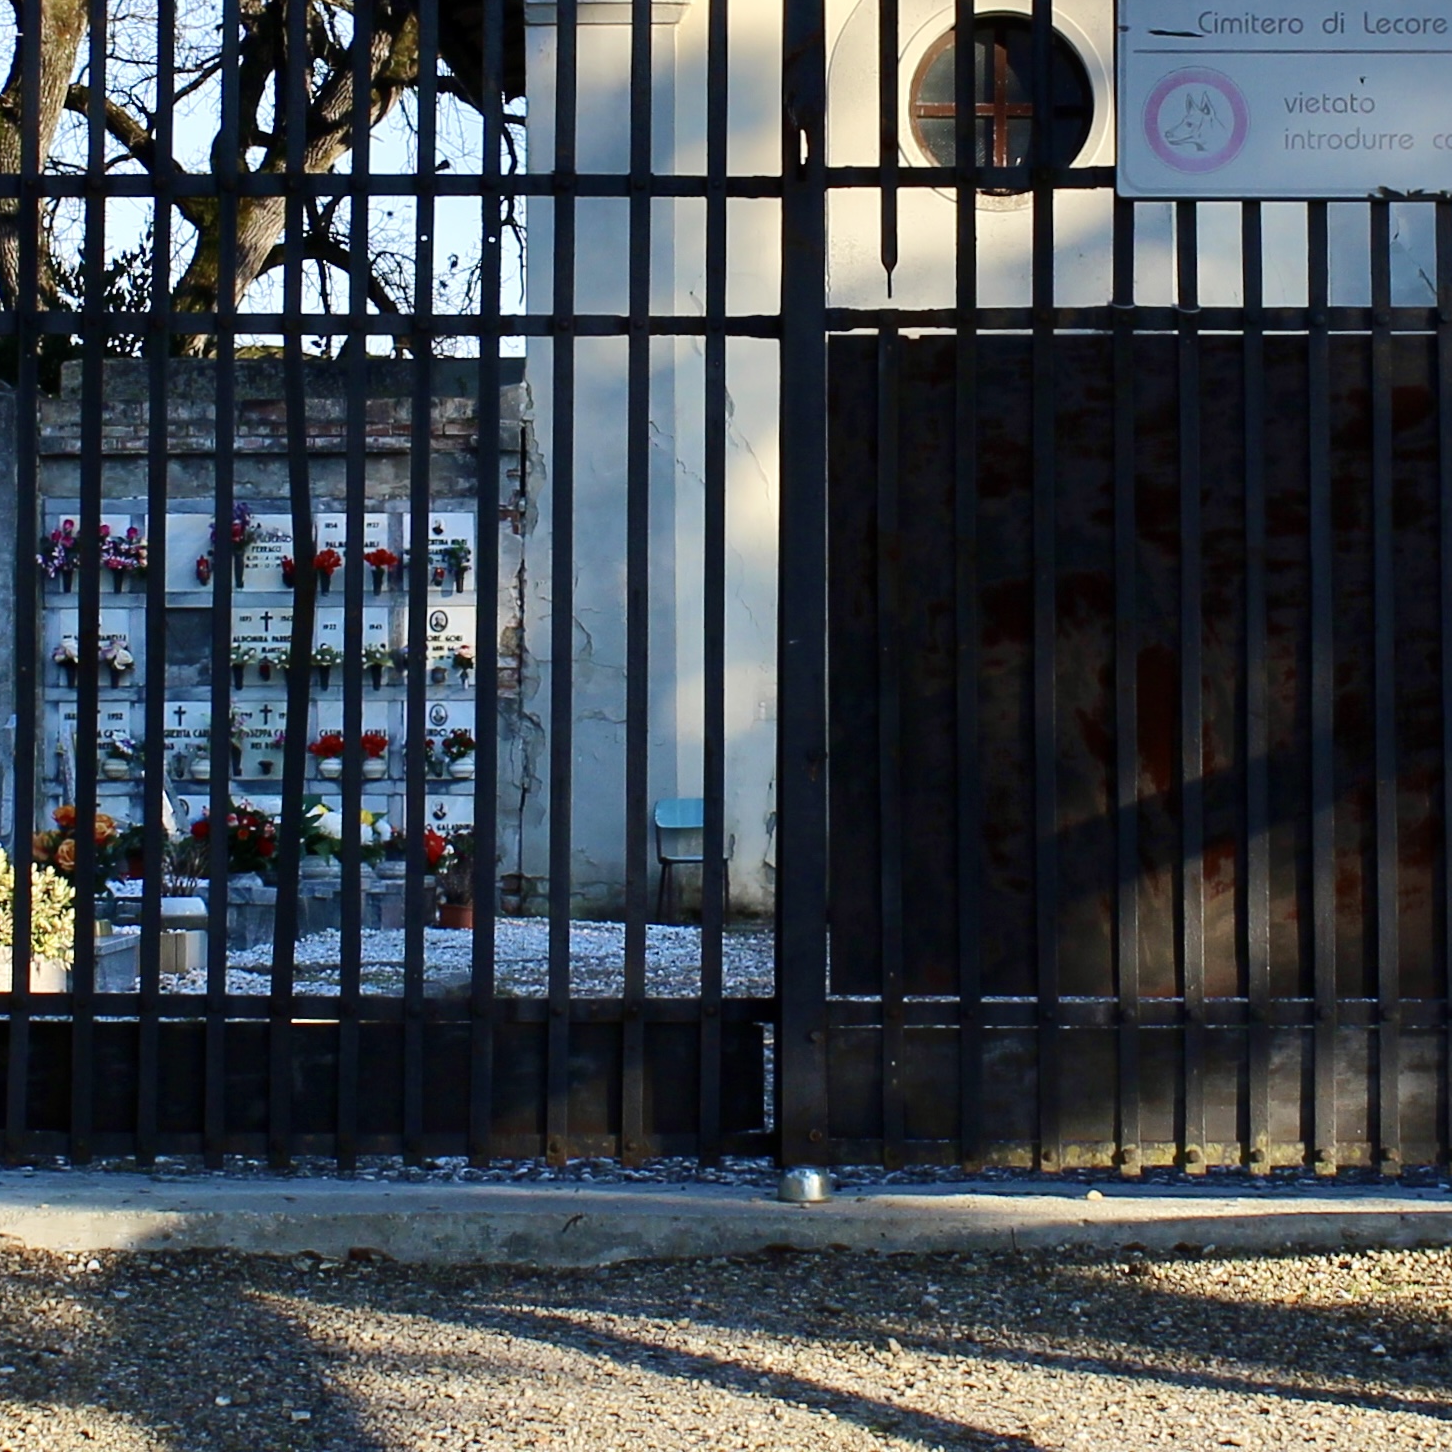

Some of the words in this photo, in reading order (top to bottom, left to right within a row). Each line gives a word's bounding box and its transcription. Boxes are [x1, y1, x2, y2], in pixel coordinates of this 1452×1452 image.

[1198, 10, 1304, 35] Cimitero
[1321, 11, 1345, 34] di
[1363, 11, 1448, 34] Lecore
[1283, 91, 1376, 114] vietato
[1283, 126, 1415, 151] introdurre
